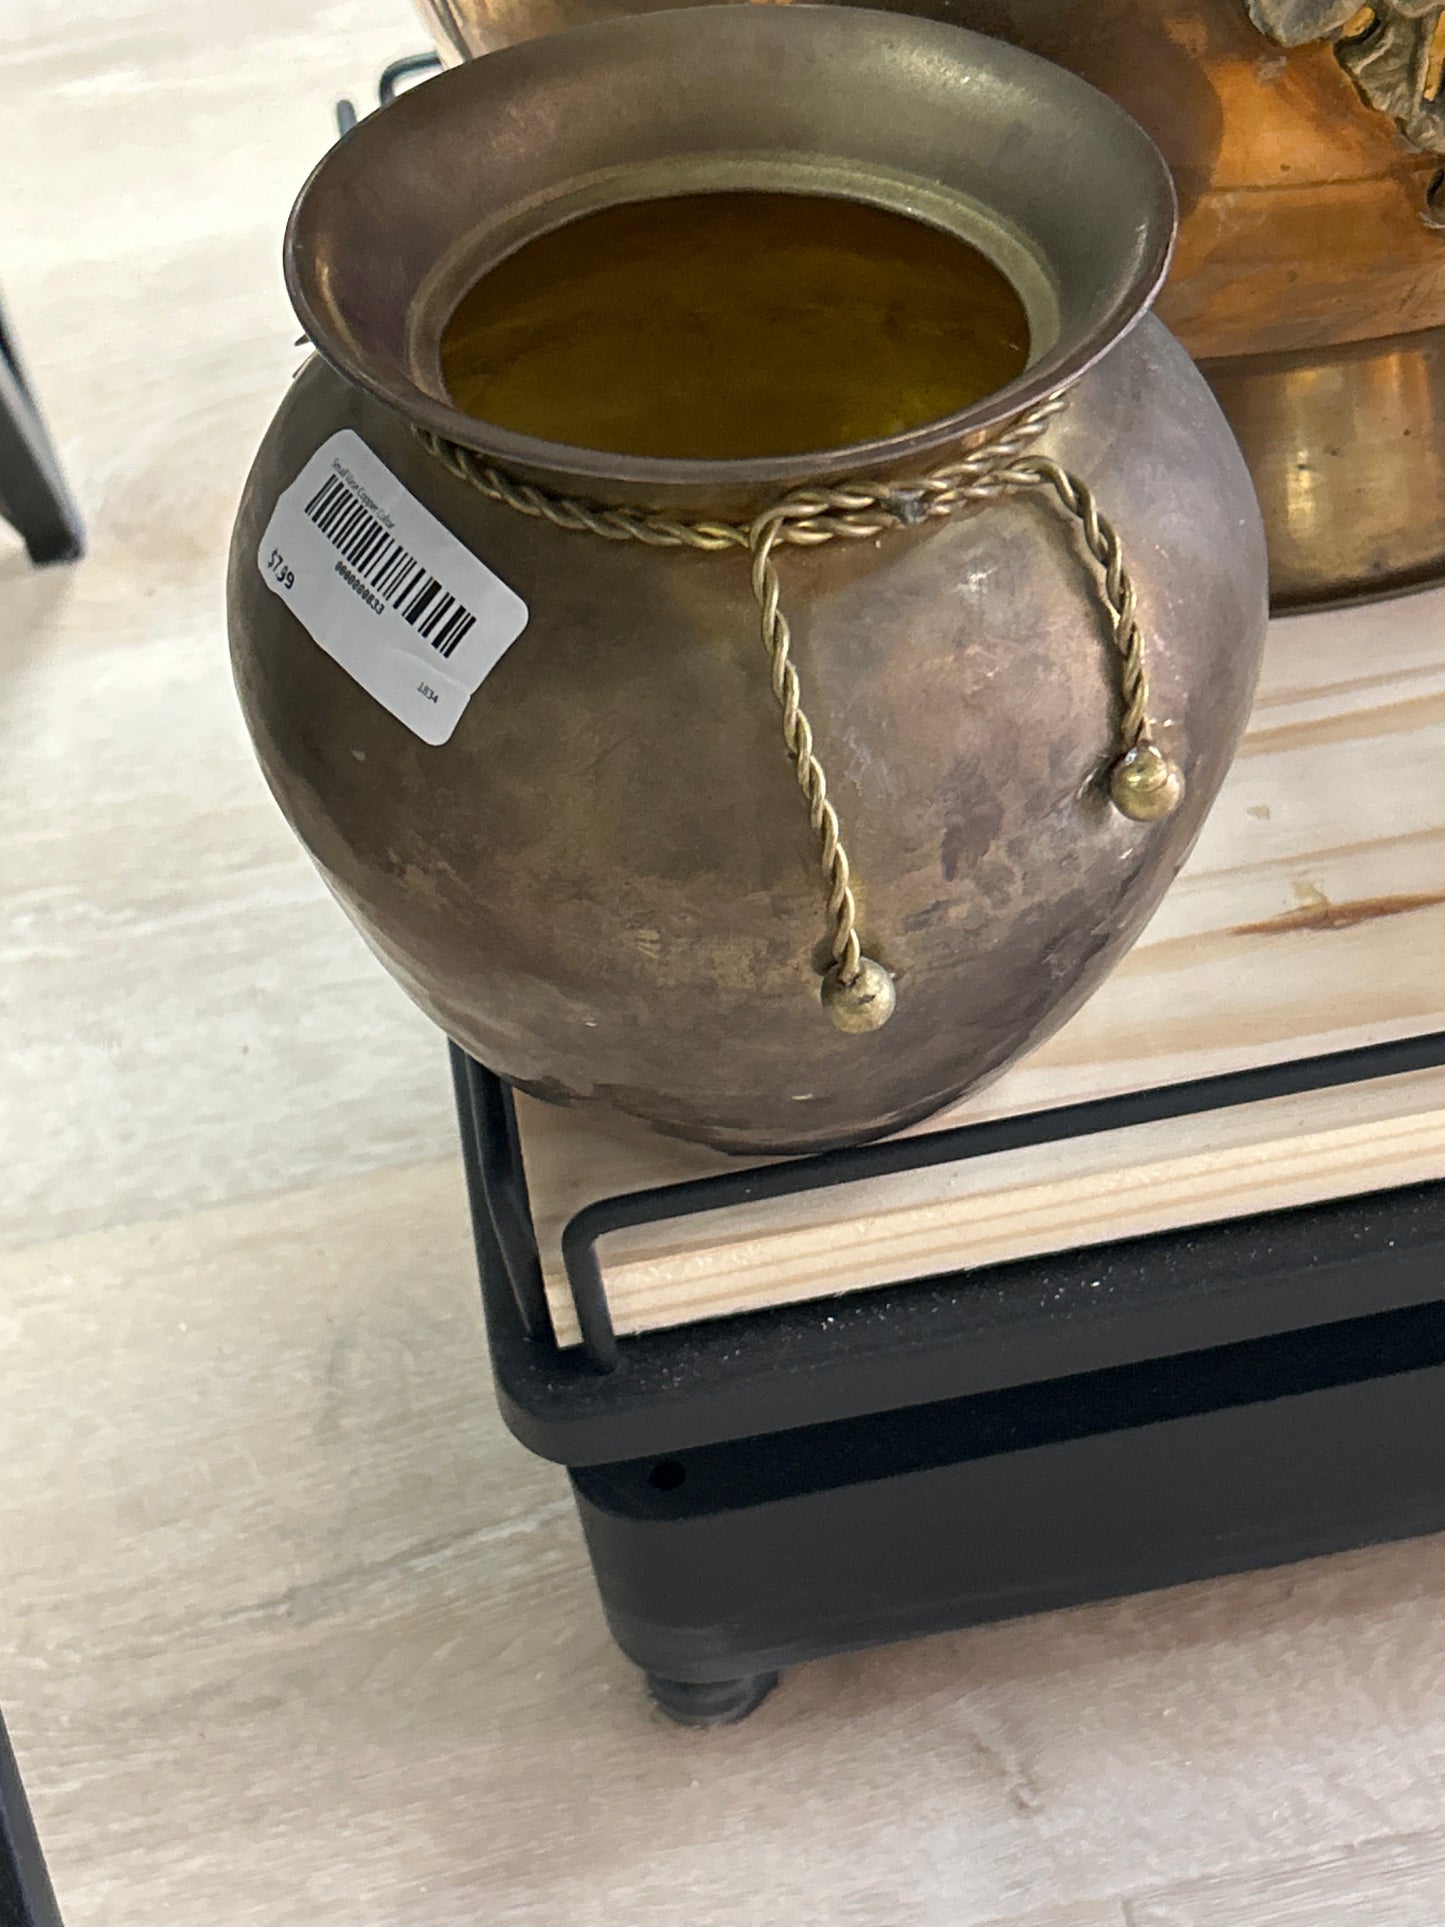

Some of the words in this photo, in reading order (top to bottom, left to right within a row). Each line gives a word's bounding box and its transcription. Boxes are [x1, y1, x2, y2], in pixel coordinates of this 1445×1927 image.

[331, 457, 349, 478] Small
[344, 473, 359, 490] Vase
[357, 486, 379, 512] Copper
[267, 548, 295, 589] $7.99
